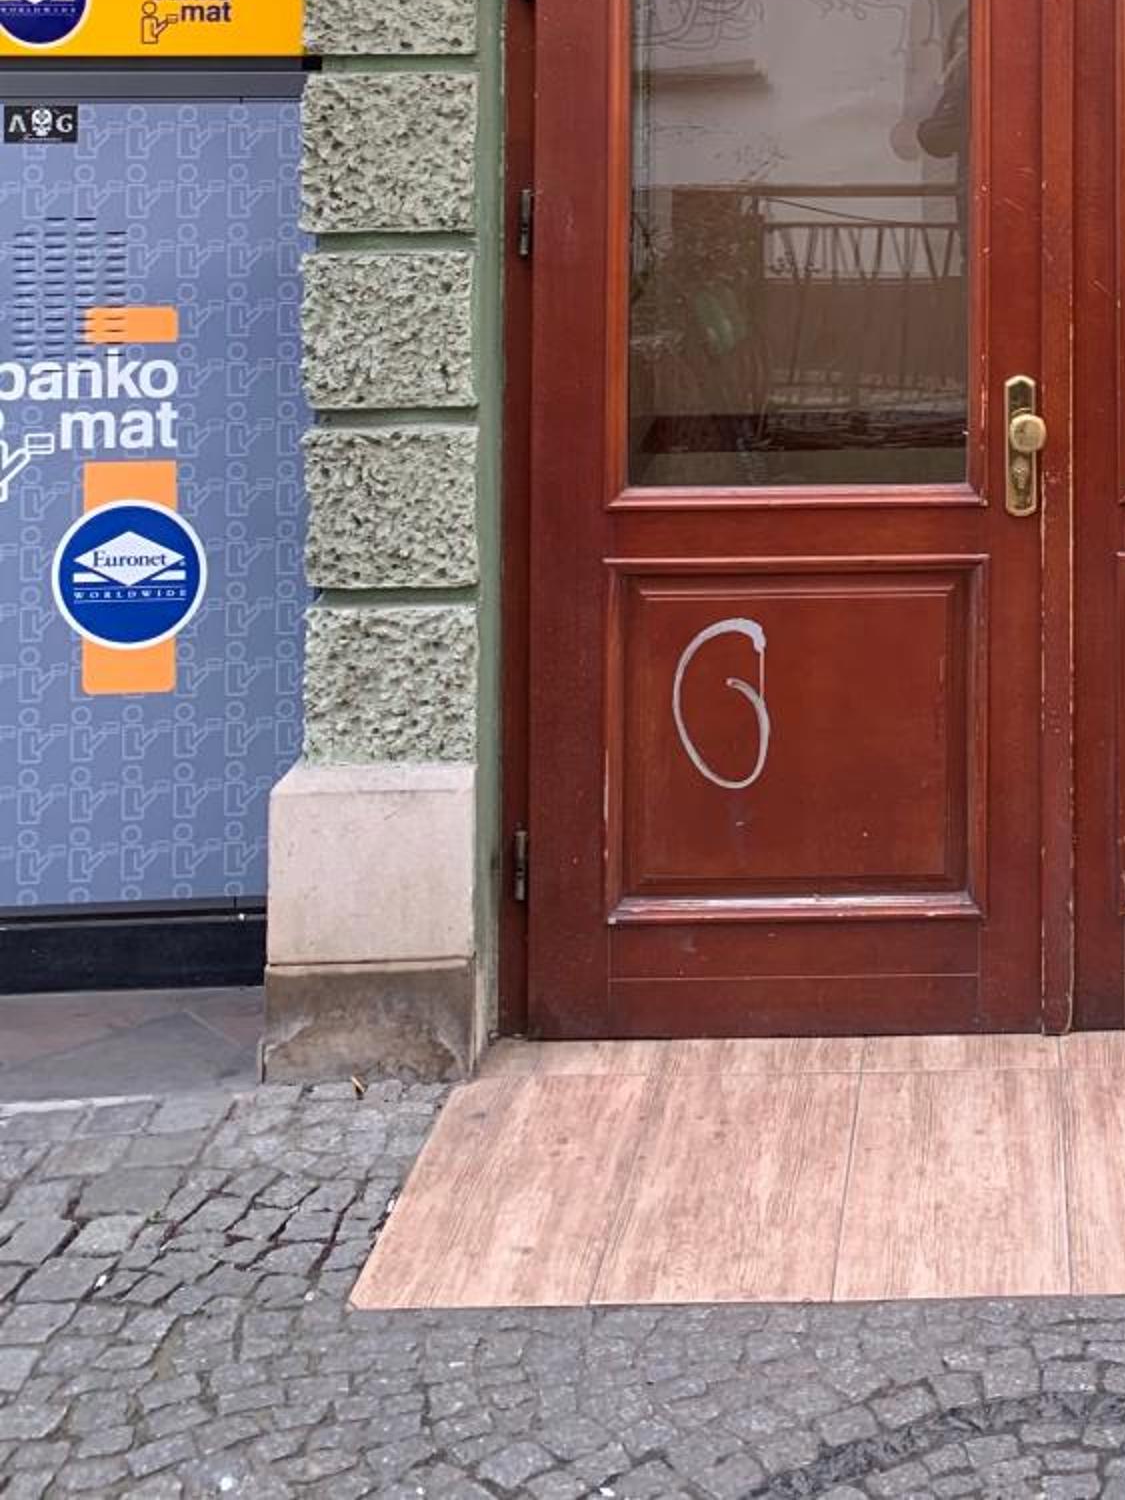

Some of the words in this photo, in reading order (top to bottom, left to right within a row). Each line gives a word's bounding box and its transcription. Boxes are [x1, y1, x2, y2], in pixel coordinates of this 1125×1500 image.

[180, 2, 232, 23] mat
[60, 401, 179, 450] mat
[93, 550, 168, 567] Euronet
[73, 589, 187, 599] WORLDWIDE
